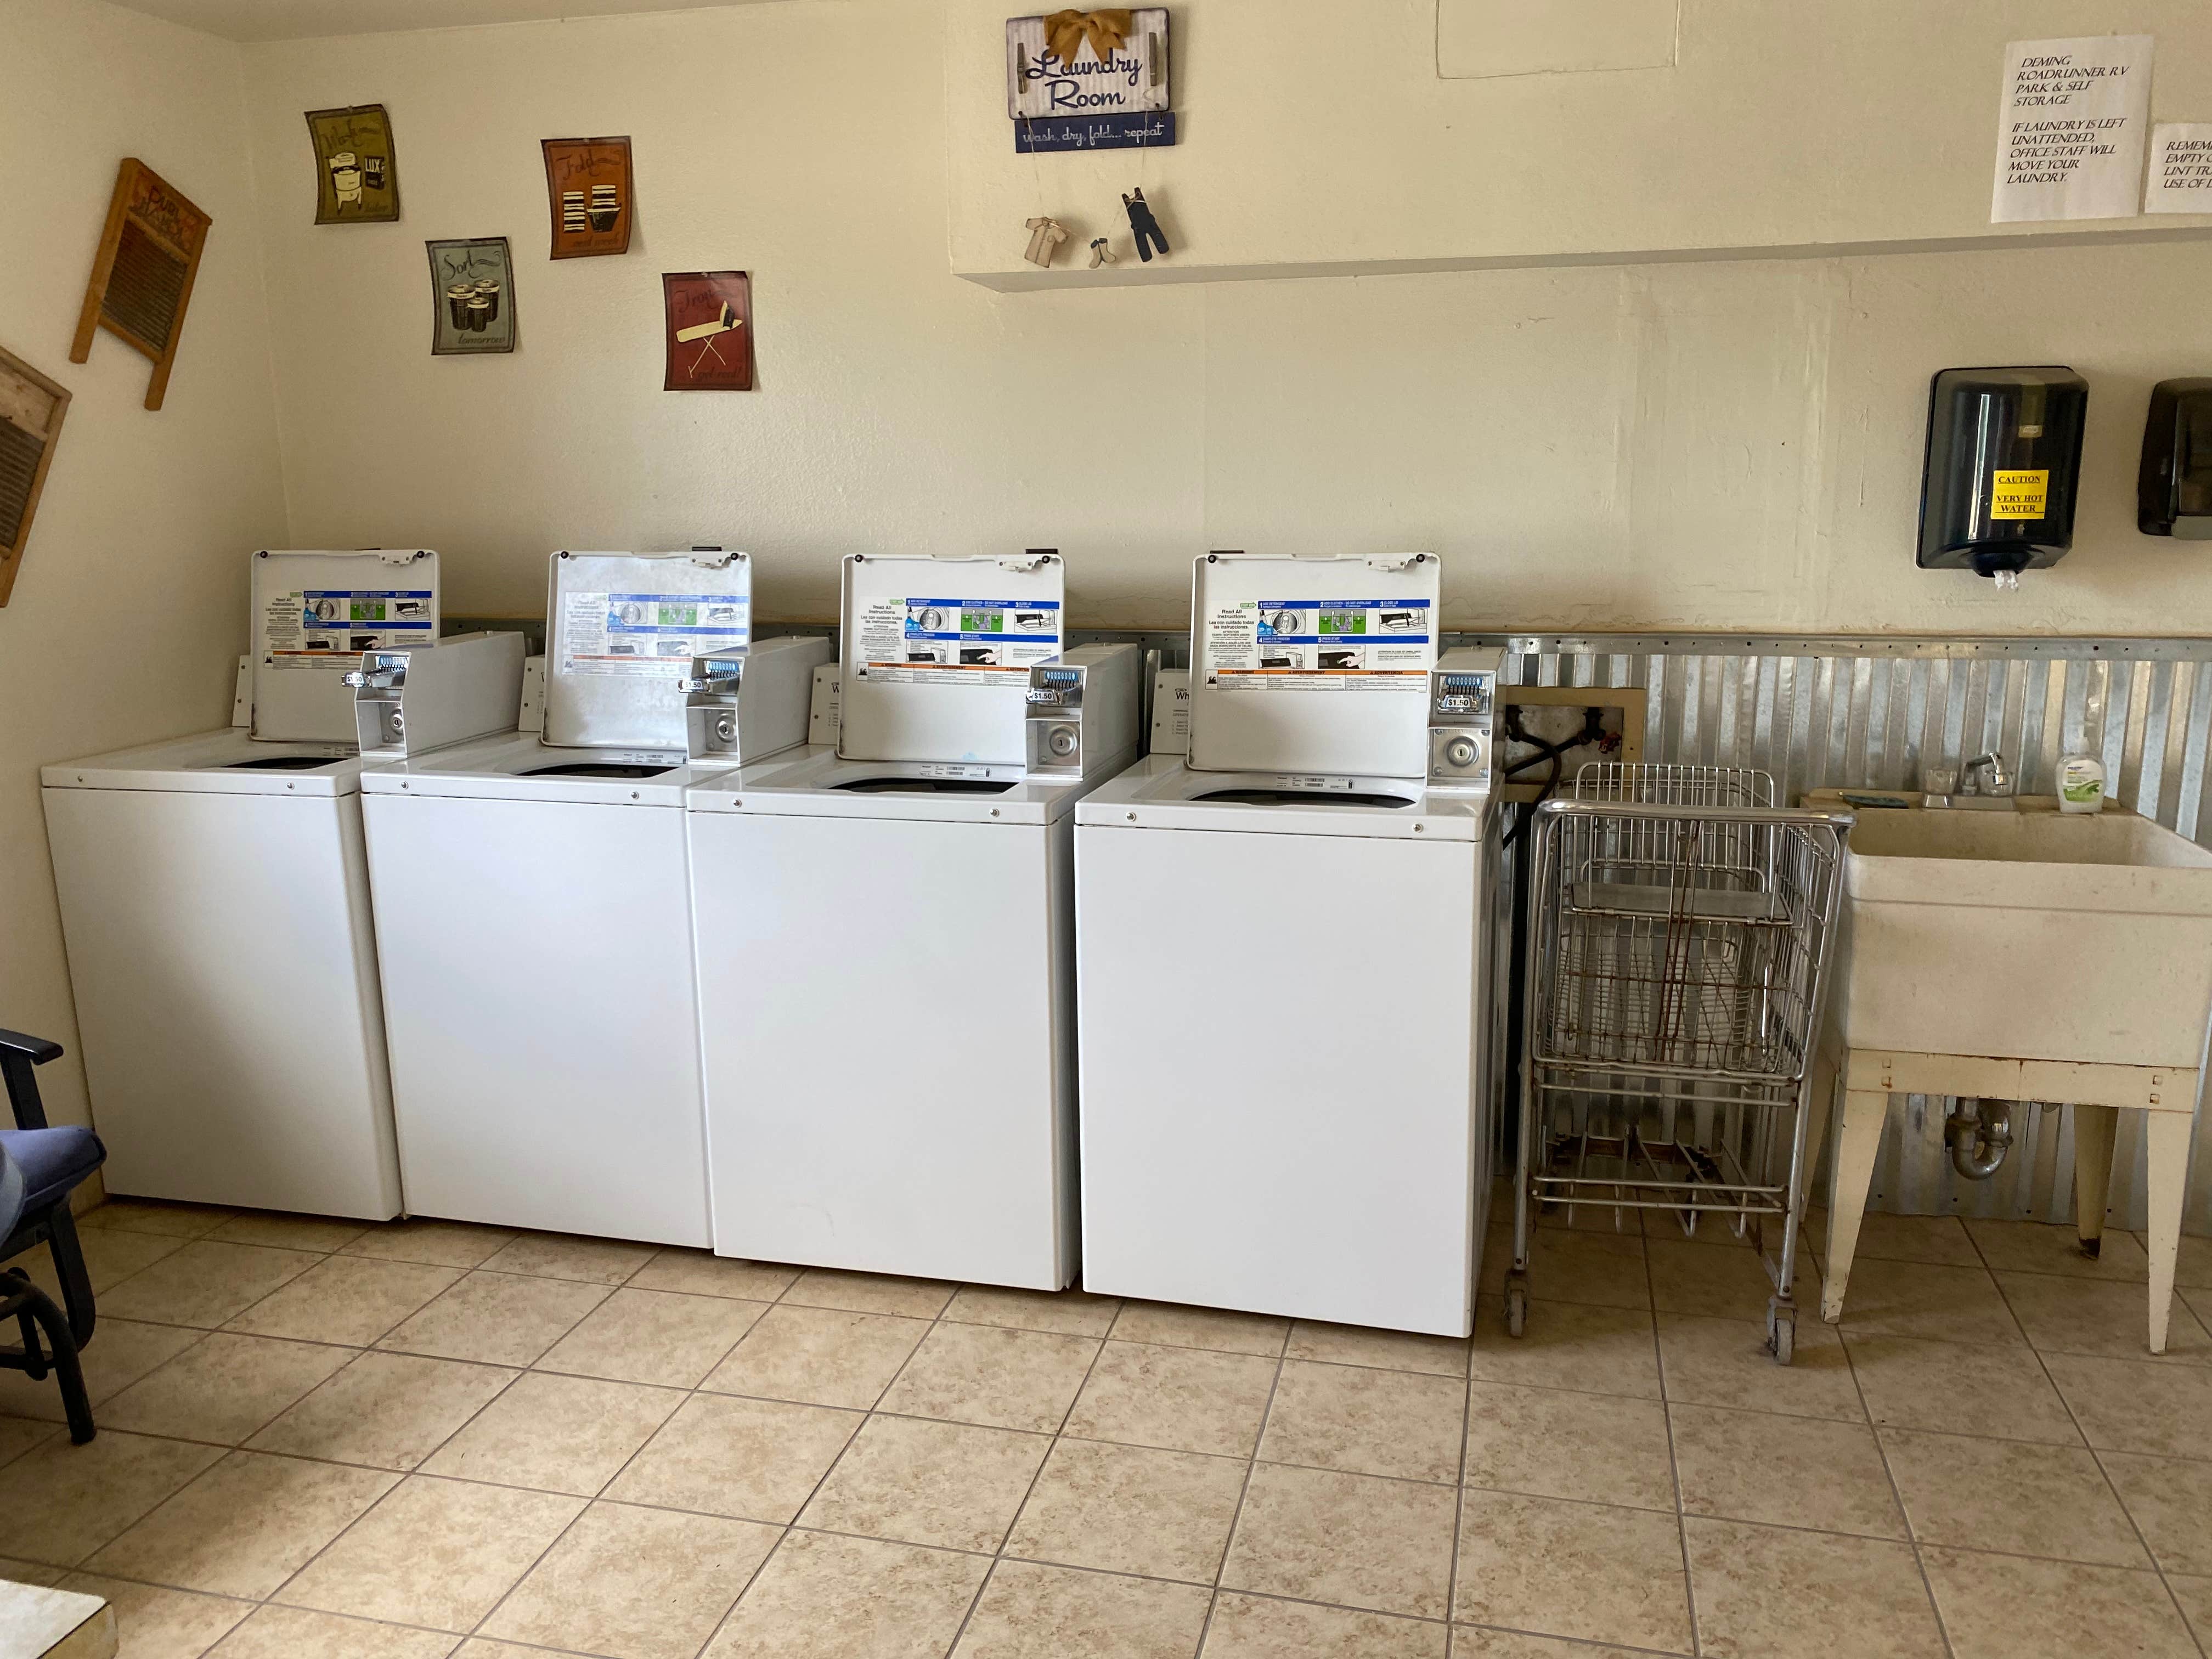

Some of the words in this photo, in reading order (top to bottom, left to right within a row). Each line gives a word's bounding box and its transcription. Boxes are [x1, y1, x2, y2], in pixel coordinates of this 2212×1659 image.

[1025, 48, 1142, 86] Laundry
[2021, 55, 2072, 67] DEMING
[2017, 67, 2106, 81] ROADRUNNER
[2015, 83, 2051, 94] PARK
[2052, 82, 2063, 92] &
[2066, 80, 2094, 91] SELF
[1045, 80, 1125, 110] Room
[2013, 94, 2072, 106] STORAGE
[2012, 122, 2024, 132] IF
[2024, 120, 2085, 132] LAUNDRY
[2085, 120, 2097, 129] IS
[2098, 118, 2129, 128] LEFT
[1062, 127, 1086, 146] dry,
[1125, 122, 1164, 143] repeat
[2012, 133, 2095, 145] UNATTENDED,
[2010, 148, 2052, 158] OFFICE
[2052, 145, 2089, 156] STAFF
[2090, 144, 2117, 155] WILL
[2166, 141, 2212, 150] REMEM
[365, 157, 381, 173] LUX
[2008, 160, 2046, 171] MOVE
[2047, 159, 2080, 168] YOUR
[2165, 154, 2206, 163] EMPTY
[2164, 166, 2193, 176] LINT
[2164, 179, 2187, 188] USE
[2188, 179, 2207, 188] OF
[440, 250, 491, 281] Sort
[458, 333, 505, 345] tomorrow
